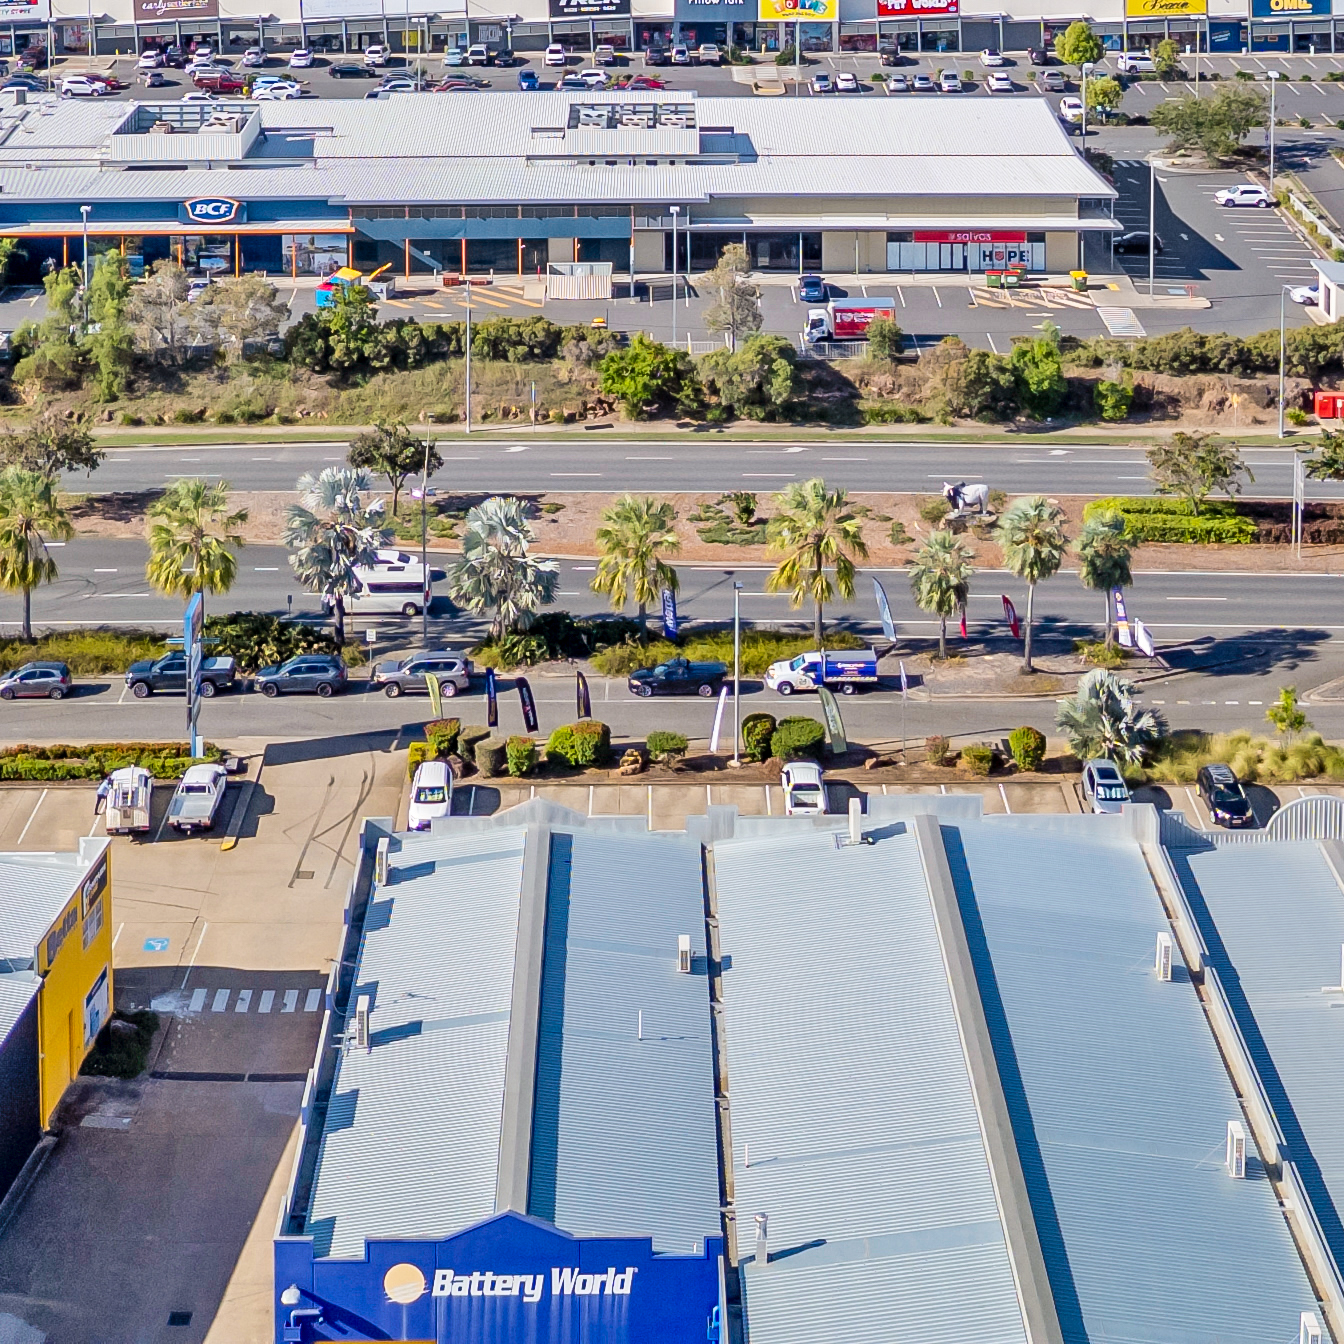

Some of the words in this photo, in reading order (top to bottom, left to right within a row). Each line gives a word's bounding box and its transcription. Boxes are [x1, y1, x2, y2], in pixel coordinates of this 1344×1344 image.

[194, 202, 230, 215] BCF
[956, 232, 991, 241] salvos
[432, 1267, 544, 1302] Battery
[551, 1266, 635, 1296] World
